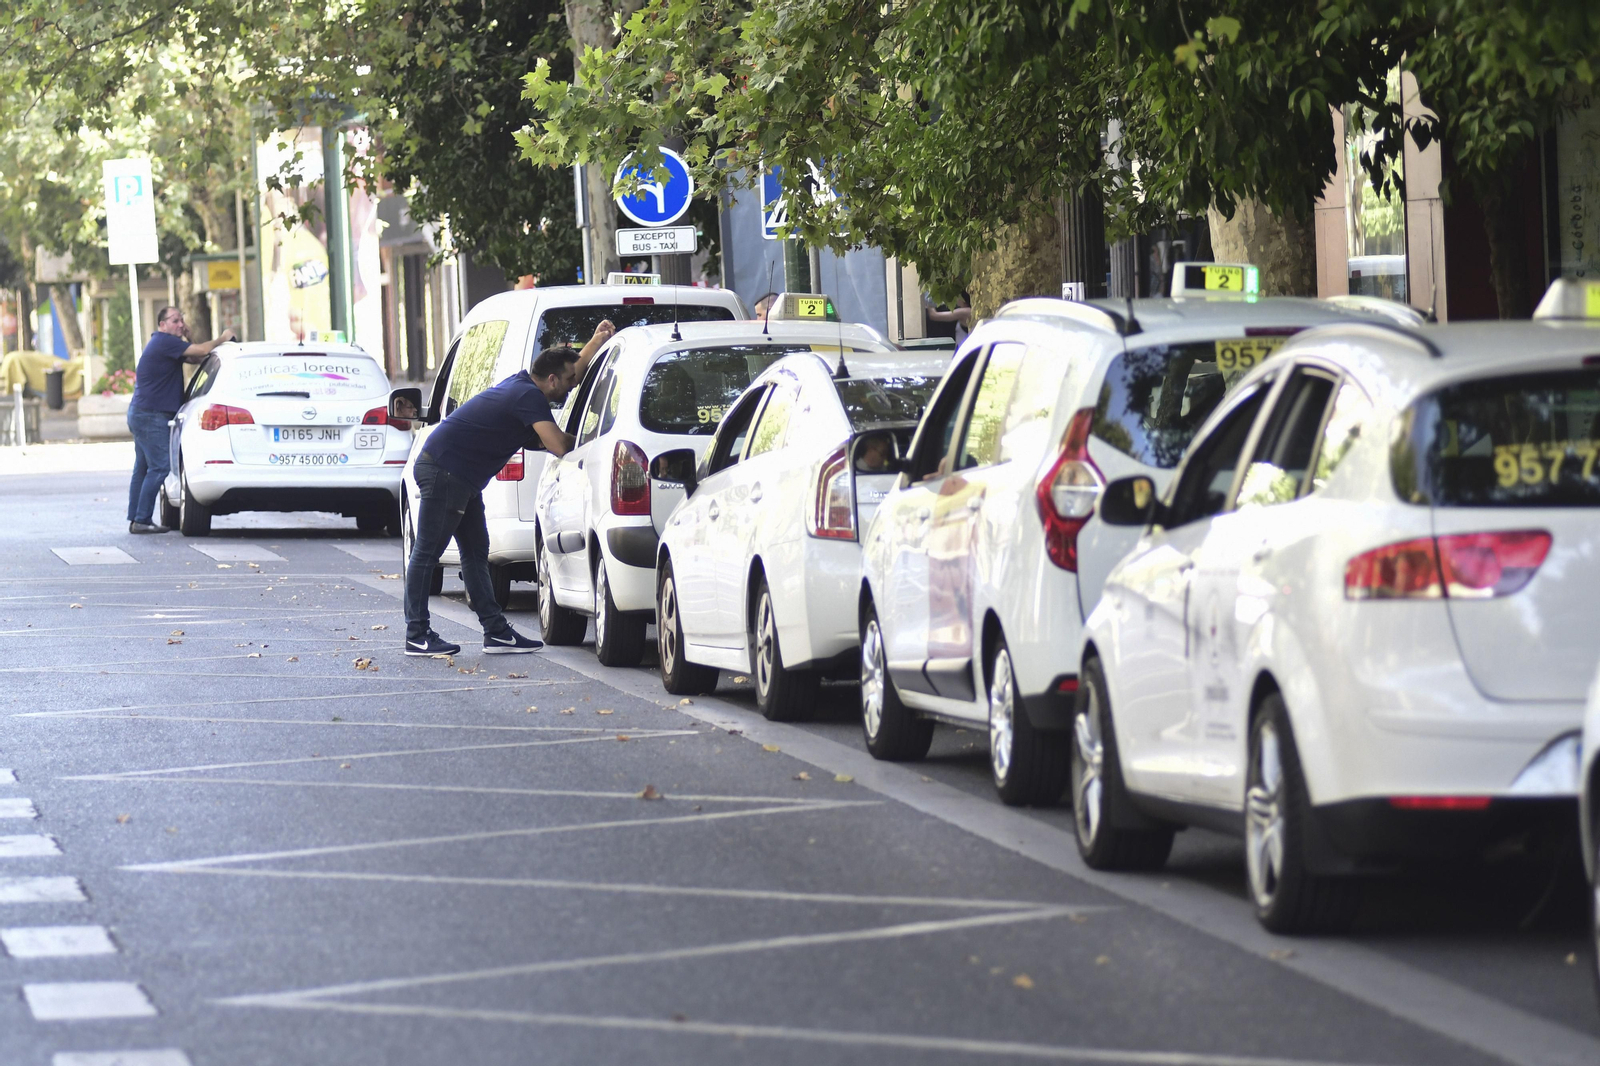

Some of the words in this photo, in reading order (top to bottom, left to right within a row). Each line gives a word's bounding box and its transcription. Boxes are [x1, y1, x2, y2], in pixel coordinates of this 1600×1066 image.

[634, 231, 676, 241] EXCEPTO
[632, 243, 652, 252] BUS
[659, 242, 678, 250] TAXI
[1209, 267, 1241, 275] TURNO
[1218, 274, 1230, 289] 2
[807, 304, 817, 315] 2
[1220, 346, 1273, 369] 957
[303, 362, 361, 375] lorente
[346, 415, 361, 423] 025
[282, 429, 314, 441] 0165
[318, 429, 341, 441] JNH
[359, 435, 379, 447] SP
[278, 454, 296, 465] 957
[299, 454, 310, 465] 45
[312, 454, 324, 465] 00
[327, 454, 339, 465] 00
